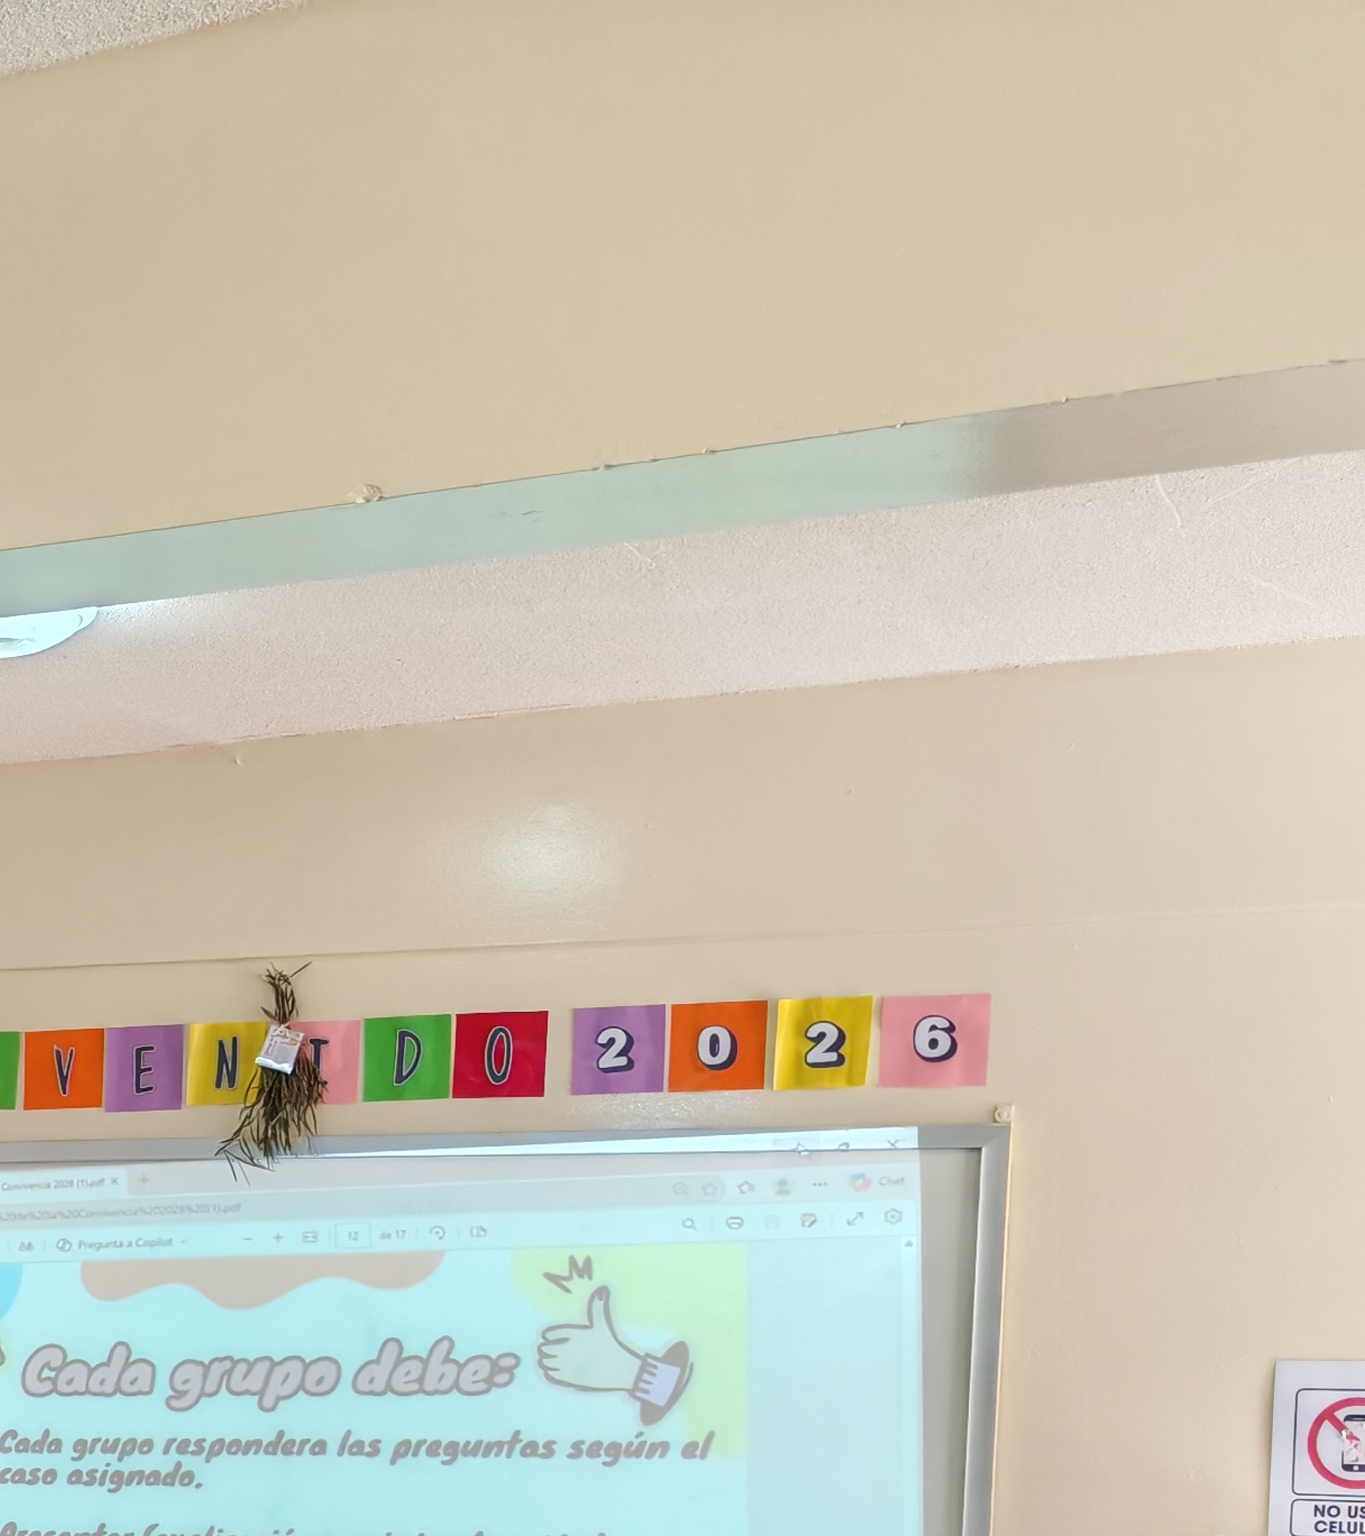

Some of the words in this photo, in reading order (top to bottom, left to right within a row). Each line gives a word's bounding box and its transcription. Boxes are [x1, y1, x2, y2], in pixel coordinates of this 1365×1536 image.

[595, 1014, 958, 1073] 2026
[878, 1176, 905, 1186] Chat
[78, 1239, 124, 1251] Pregunta
[135, 1236, 173, 1250] Copilot
[379, 1230, 392, 1240] de
[22, 1341, 155, 1398] Cada
[166, 1352, 341, 1411] grupo
[353, 1336, 521, 1397] debe:
[72, 1434, 154, 1462] grupo
[163, 1431, 327, 1461] respondera
[337, 1429, 381, 1458] las
[390, 1430, 556, 1465] preguntas
[567, 1431, 669, 1467] según
[680, 1430, 715, 1460] el
[66, 1461, 203, 1492] asignado.
[1313, 1504, 1341, 1518] NO
